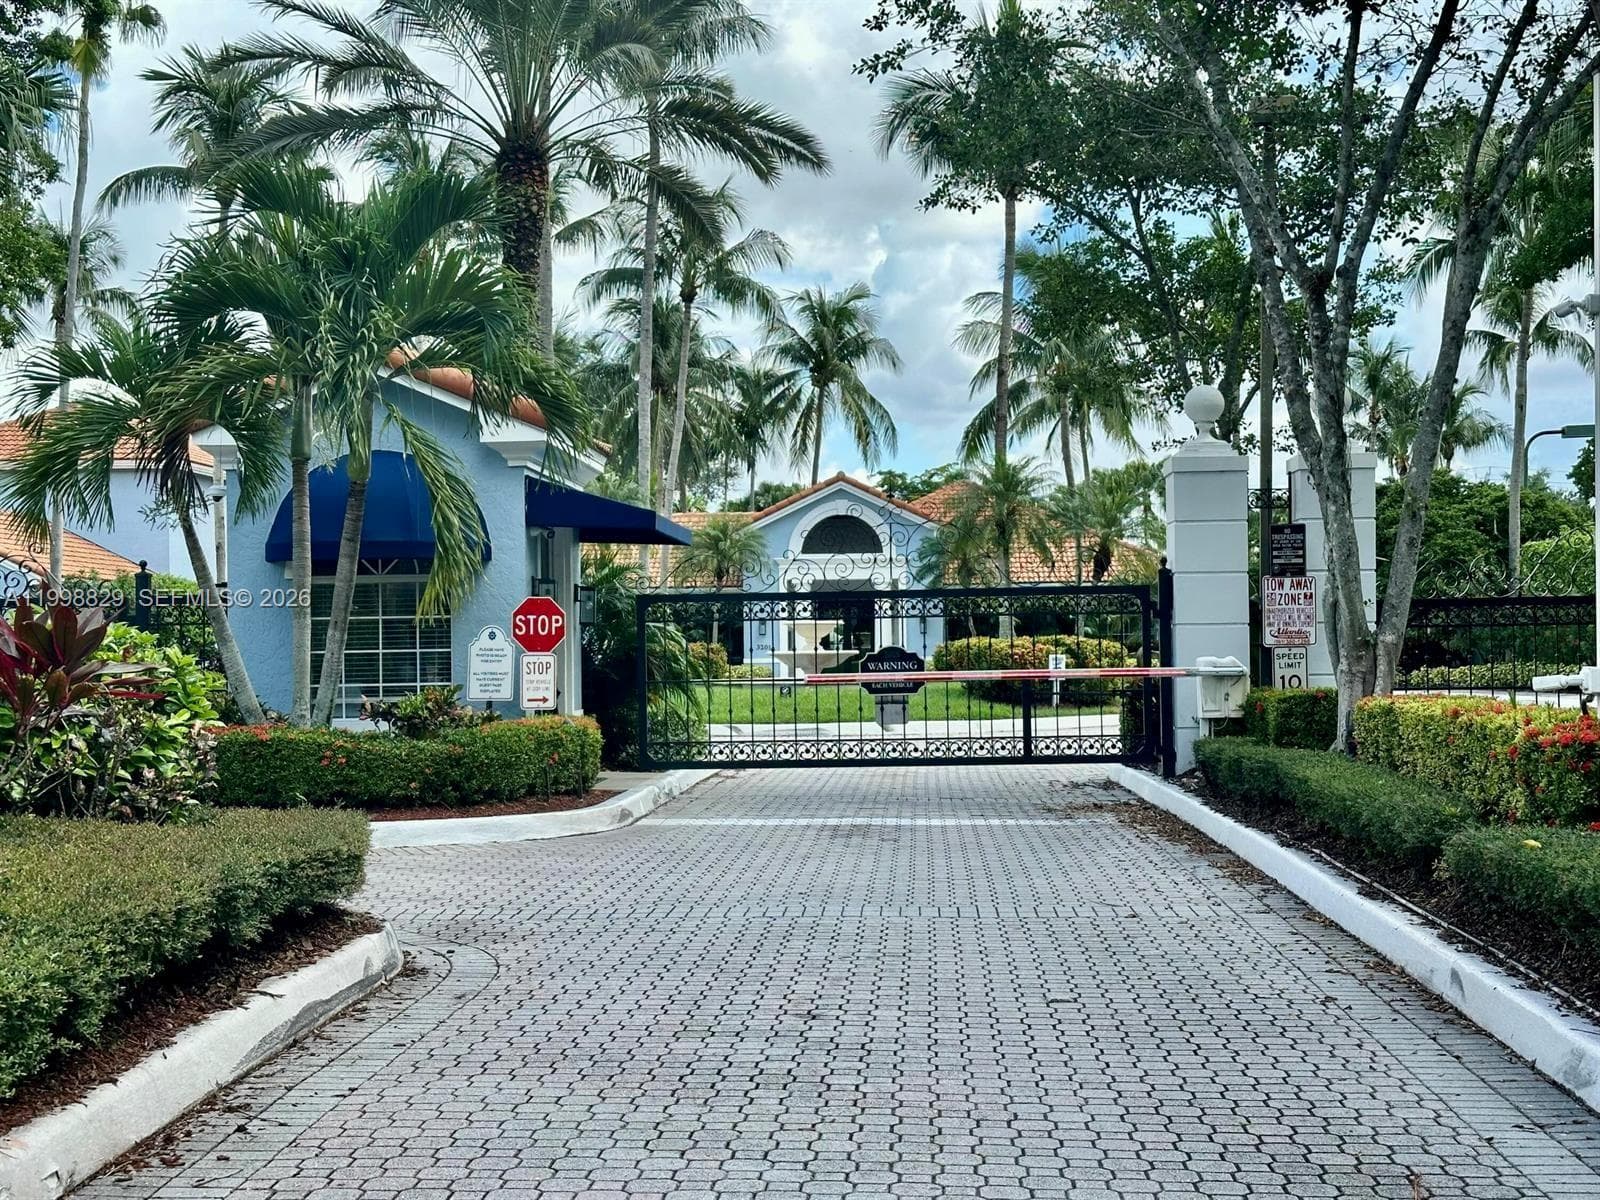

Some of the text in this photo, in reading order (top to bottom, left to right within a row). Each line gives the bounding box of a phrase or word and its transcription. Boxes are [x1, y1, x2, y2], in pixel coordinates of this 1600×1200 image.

[1266, 578, 1314, 591] TOW AWAY
[1278, 593, 1302, 606] ZONE
[515, 615, 562, 635] STOP
[526, 661, 552, 675] STOP
[867, 661, 918, 670] WARNING
[1280, 674, 1302, 689] 10
